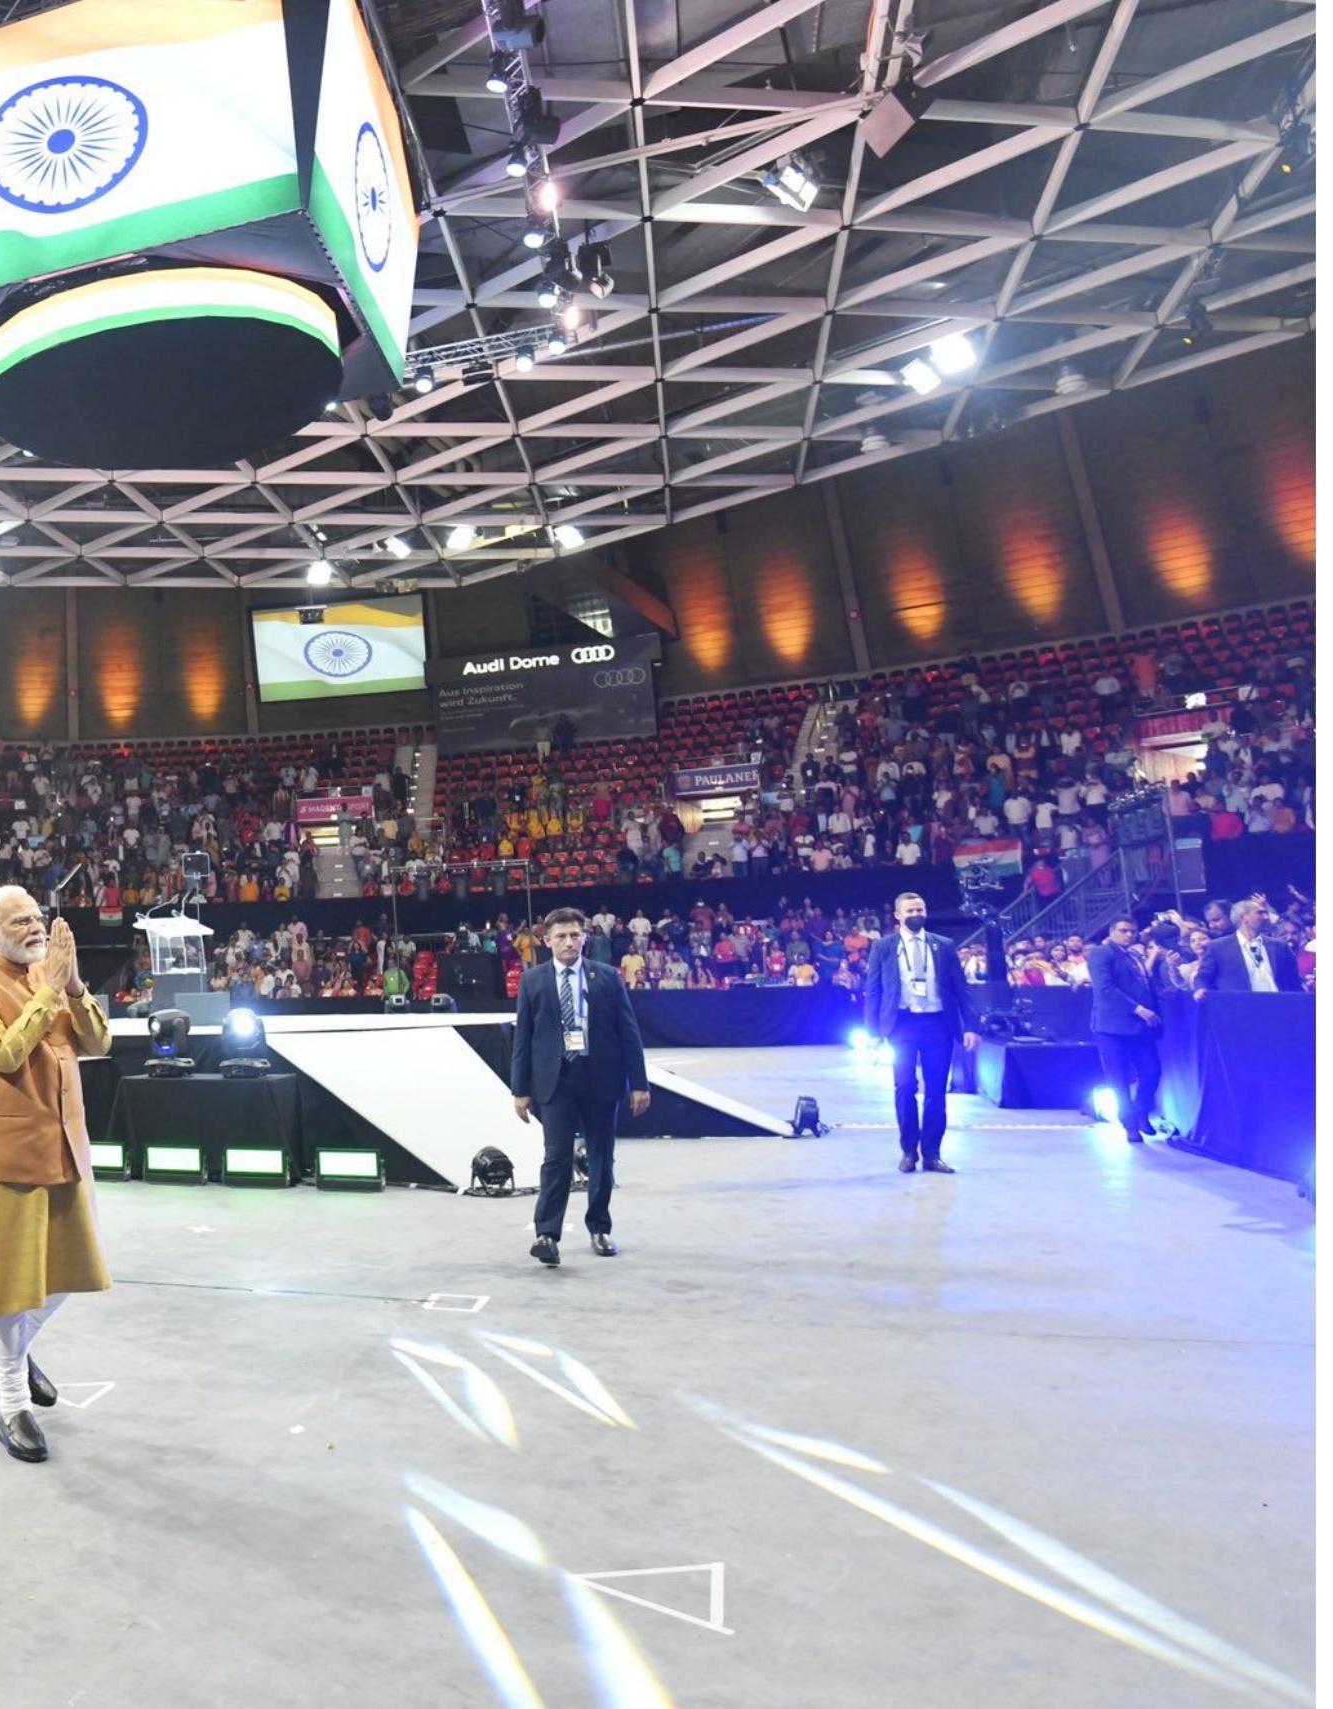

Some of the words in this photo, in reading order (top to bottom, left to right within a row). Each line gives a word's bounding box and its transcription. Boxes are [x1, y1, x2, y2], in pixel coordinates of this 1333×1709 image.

[463, 658, 505, 675] Audi
[509, 655, 560, 670] Dome
[438, 688, 461, 698] Aus
[463, 682, 524, 697] Inspiration
[439, 698, 464, 708] wird
[467, 693, 517, 706] Zukunft.
[308, 803, 344, 813] MAGENT
